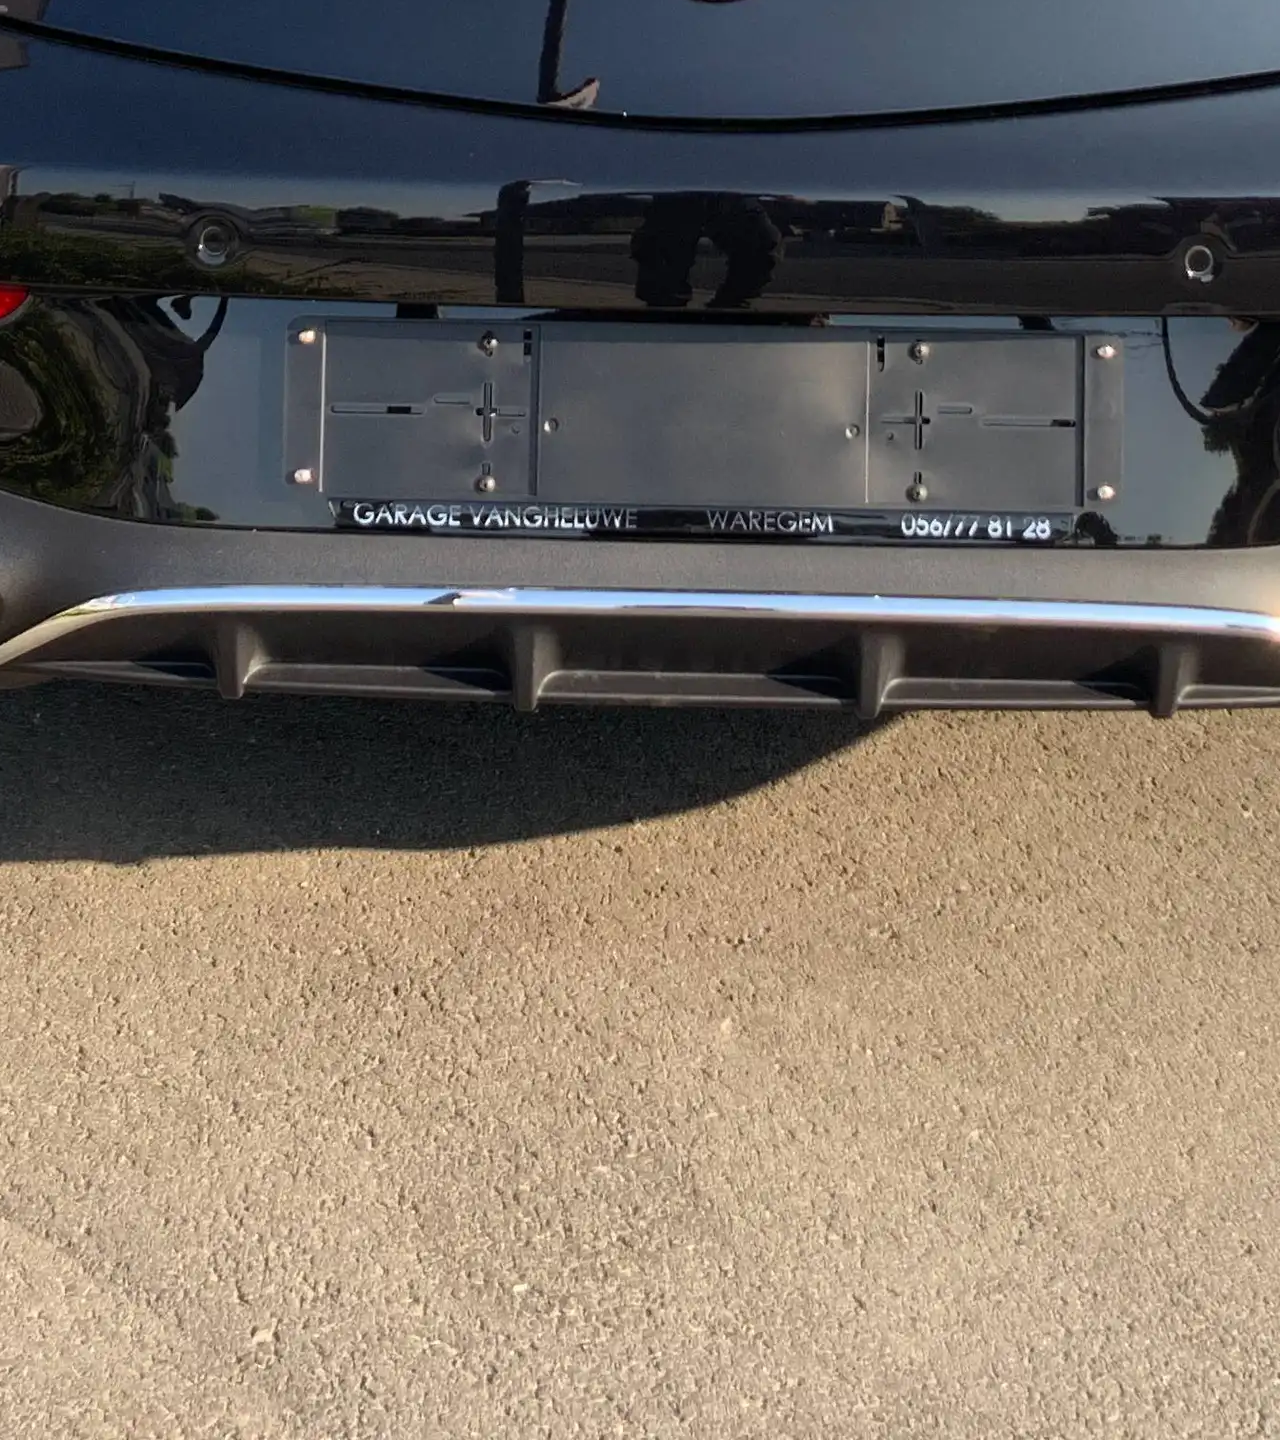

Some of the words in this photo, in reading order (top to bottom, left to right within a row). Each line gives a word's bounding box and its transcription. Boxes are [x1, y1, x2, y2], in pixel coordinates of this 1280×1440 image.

[353, 502, 462, 527] GARAGE
[469, 504, 638, 530] VANGHELUWE
[705, 509, 834, 534] WAREGEM
[900, 512, 980, 539] 056/77
[986, 515, 1014, 539] 81
[1021, 516, 1052, 540] 28
